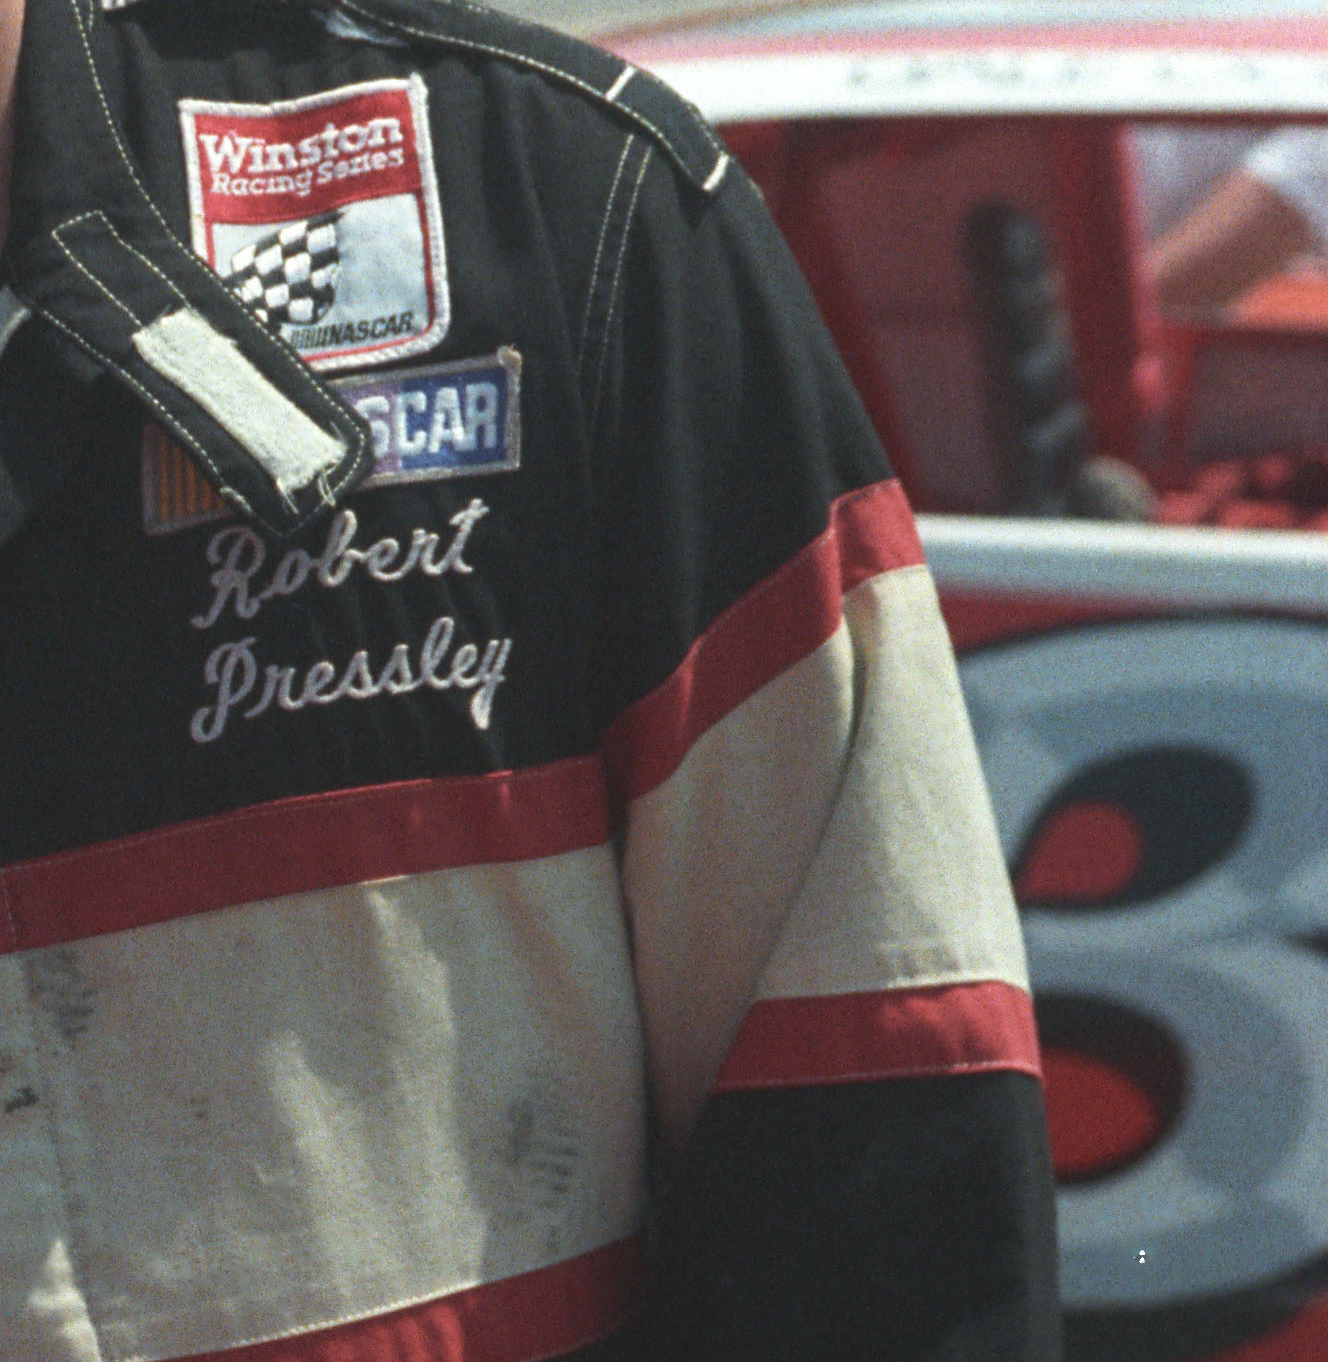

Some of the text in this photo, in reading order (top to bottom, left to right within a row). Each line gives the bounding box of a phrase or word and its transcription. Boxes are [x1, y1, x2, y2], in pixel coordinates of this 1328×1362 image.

[199, 116, 405, 174] Winston
[211, 146, 405, 197] Racing Series
[328, 309, 413, 345] NASCAR
[355, 381, 499, 459] SCAR
[190, 498, 490, 629] Robert
[190, 616, 512, 743] Pressley
